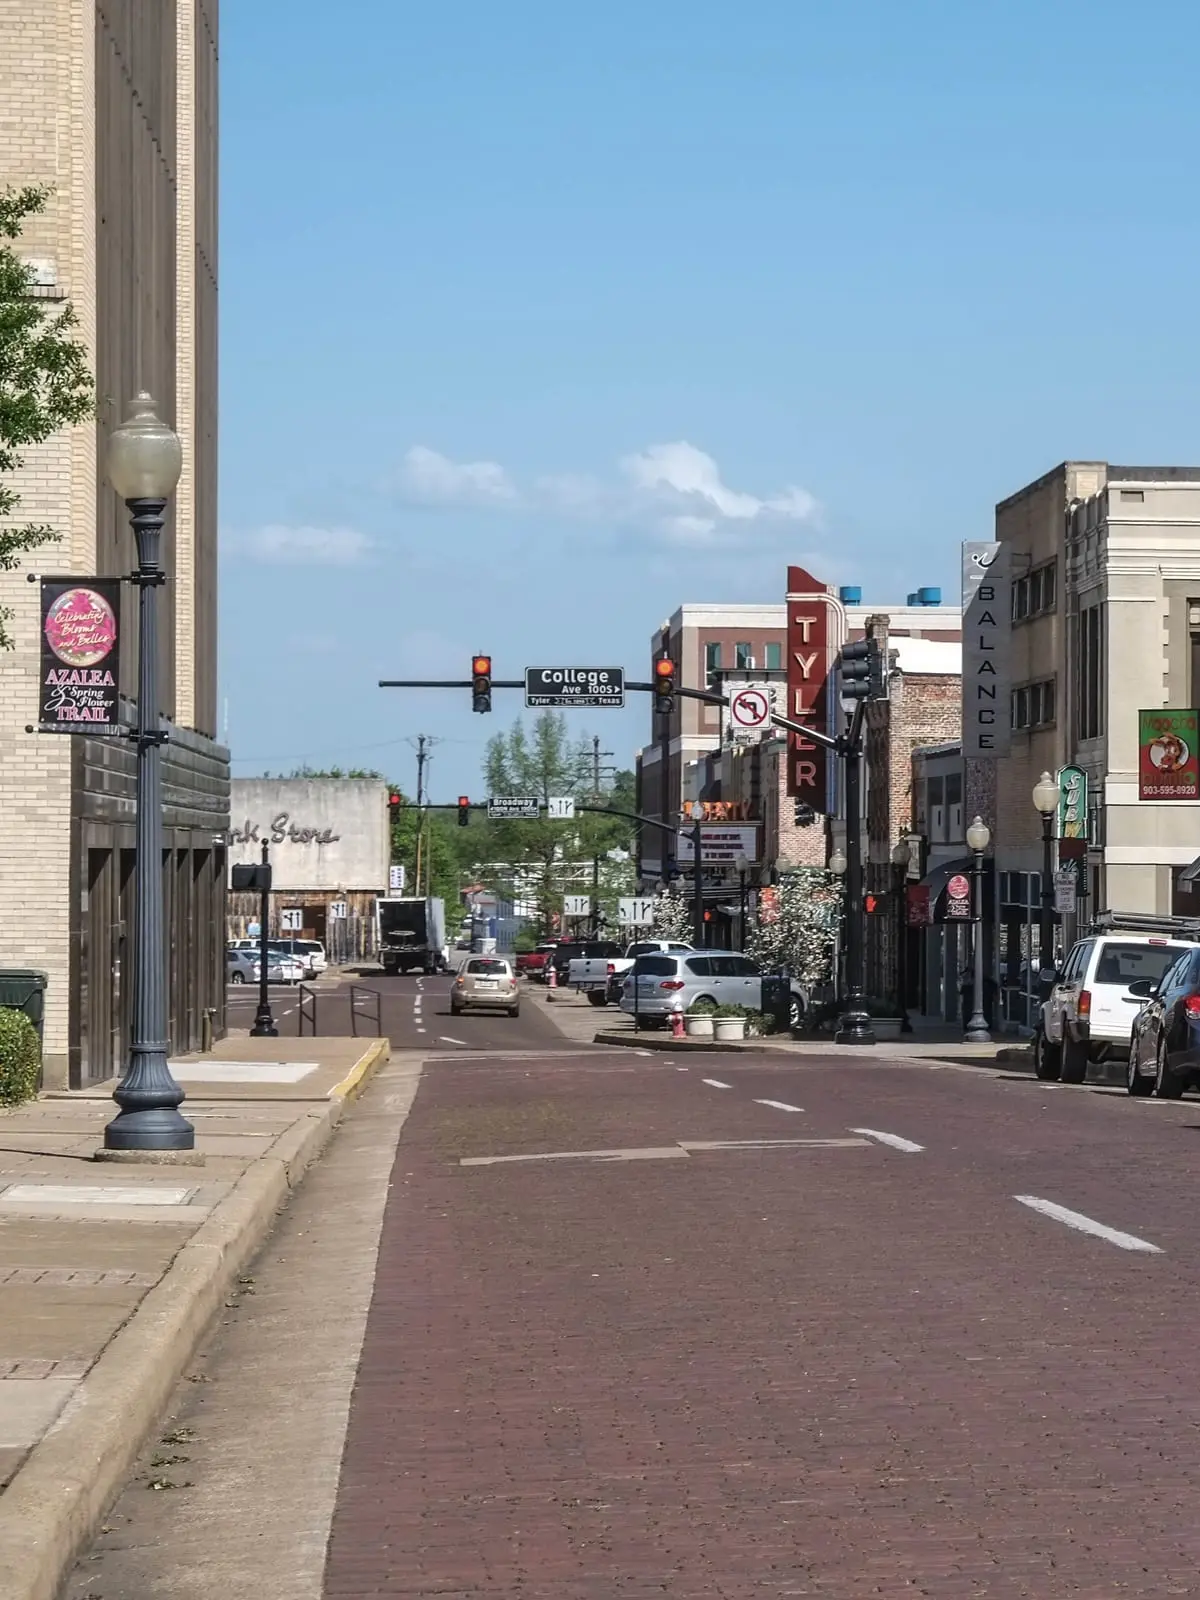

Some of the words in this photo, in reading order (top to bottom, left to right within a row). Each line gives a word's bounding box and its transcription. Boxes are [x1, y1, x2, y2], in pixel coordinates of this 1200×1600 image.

[55, 609, 105, 624] Celebrating
[977, 586, 997, 749] BALANCE
[45, 669, 115, 686] AZALEA
[541, 670, 609, 686] College
[70, 686, 105, 699] Spring
[561, 685, 581, 694] Ave
[587, 685, 613, 694] 100S
[77, 697, 114, 707] Flower
[531, 697, 550, 705] Tyler
[793, 616, 819, 788] TYLER
[55, 706, 110, 722] TRAIL
[1143, 785, 1196, 795] 903-595-8920
[493, 799, 534, 808] Broadway
[270, 812, 342, 843] Store
